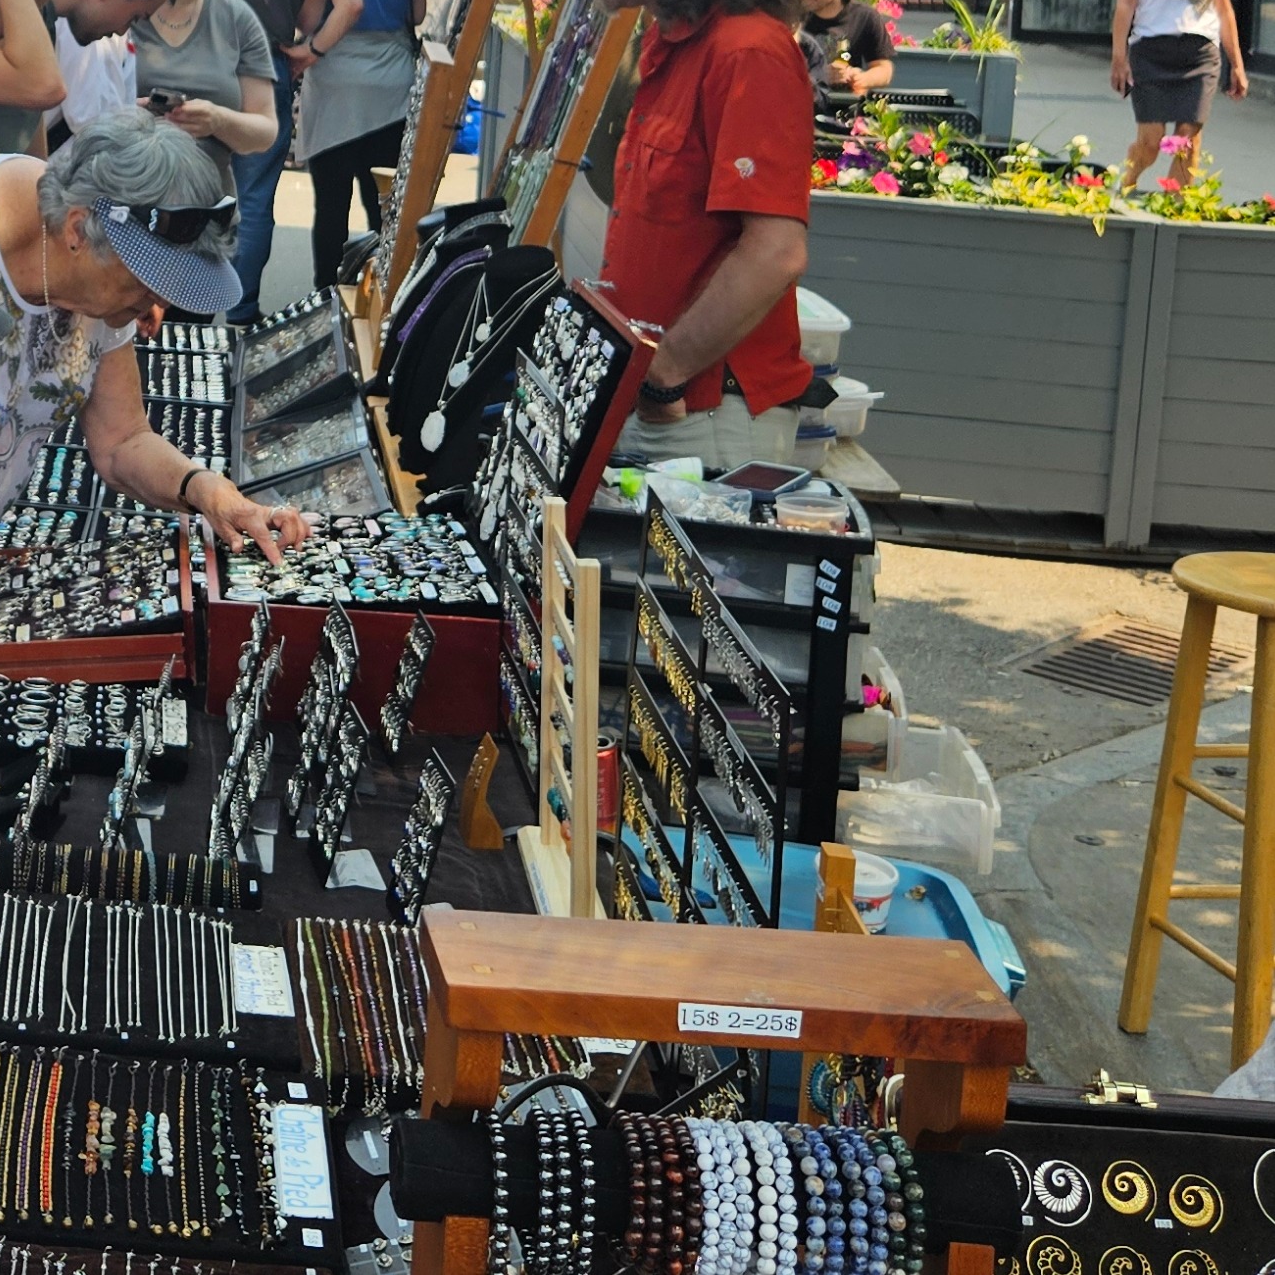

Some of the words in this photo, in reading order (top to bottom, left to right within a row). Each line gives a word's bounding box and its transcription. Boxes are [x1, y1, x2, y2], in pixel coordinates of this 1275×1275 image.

[681, 1008, 719, 1026] 15$
[728, 1011, 798, 1032] 2=25$
[278, 1107, 319, 1154] Chaîne
[284, 1155, 311, 1168] de
[283, 1171, 329, 1210] Pied
